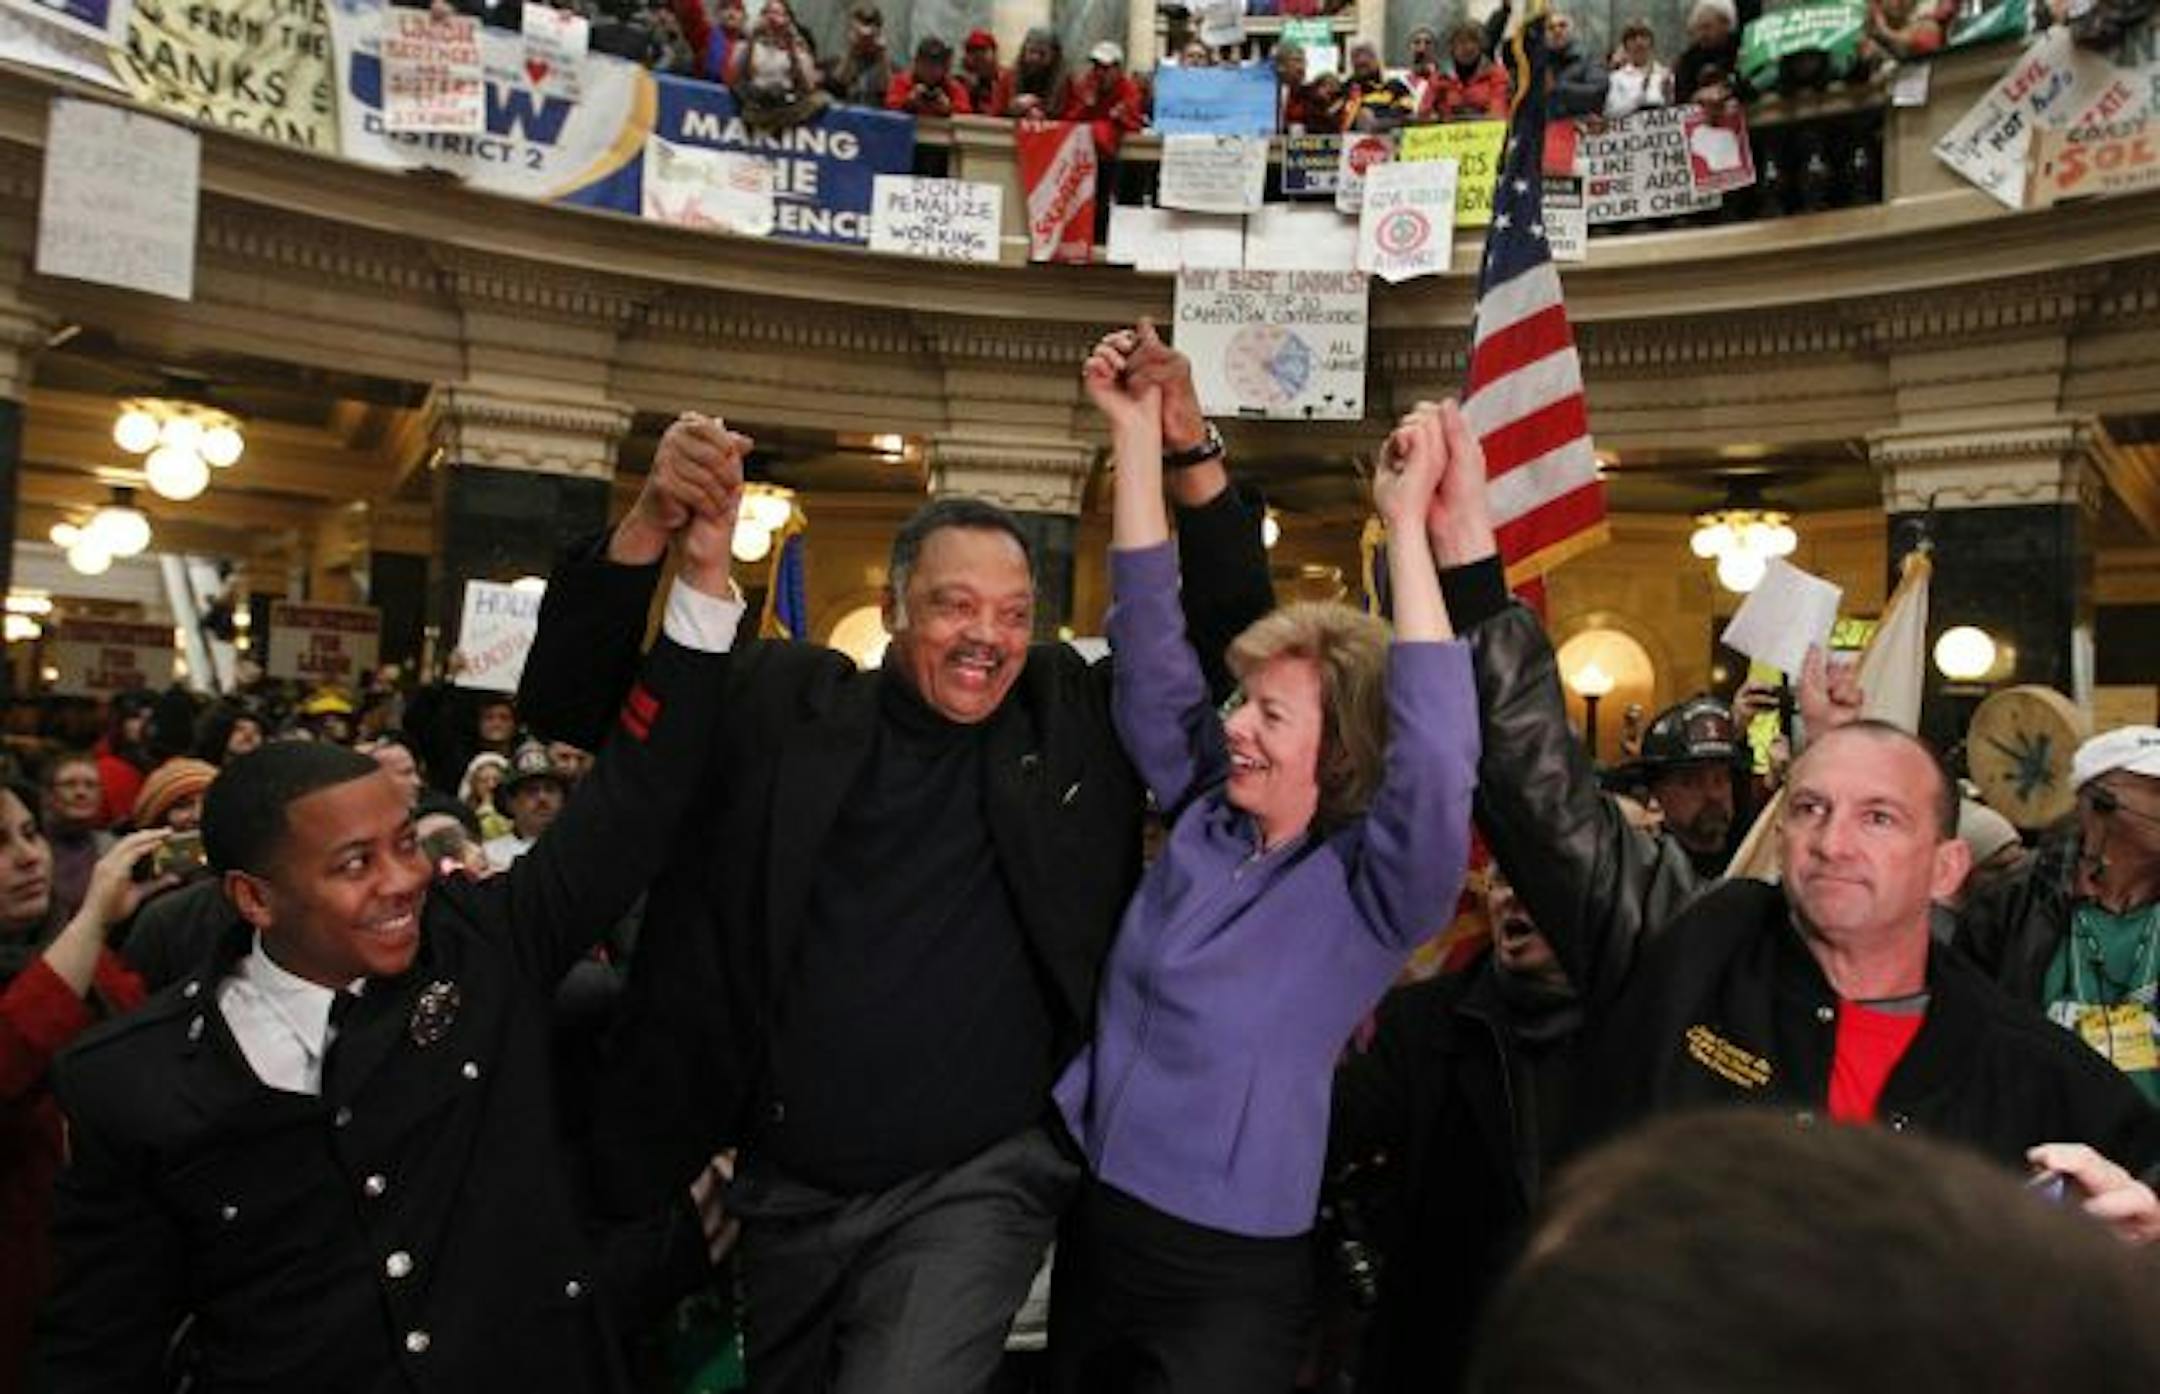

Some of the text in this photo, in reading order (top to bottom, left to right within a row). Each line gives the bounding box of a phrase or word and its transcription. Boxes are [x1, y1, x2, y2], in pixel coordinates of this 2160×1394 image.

[681, 109, 860, 161] MAKING
[525, 150, 546, 171] 2
[770, 154, 819, 195] HE
[887, 192, 994, 220] PENALIZE
[888, 224, 986, 251] WORKING
